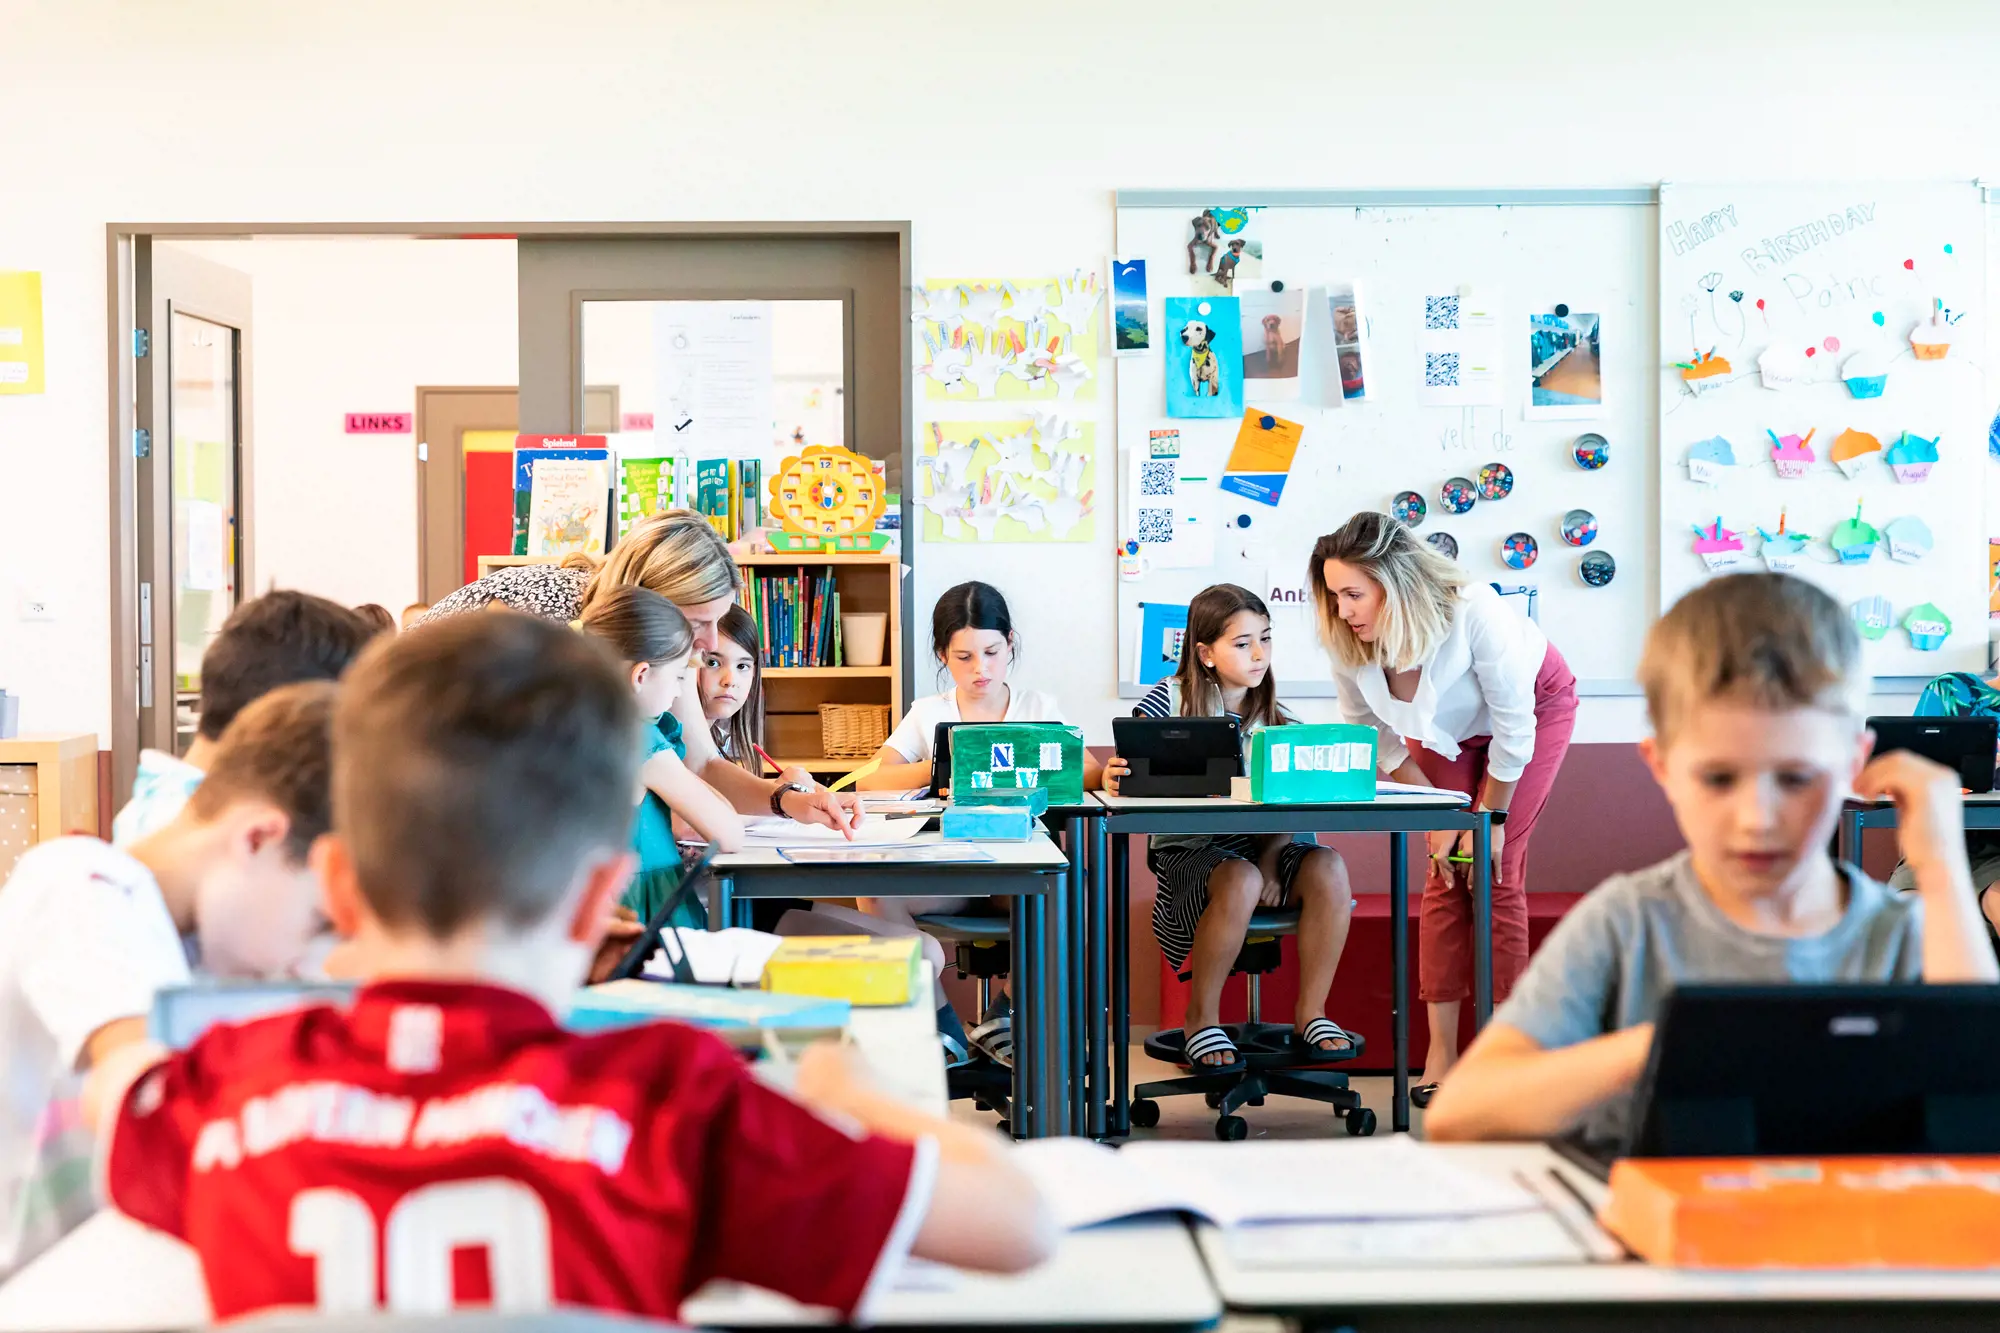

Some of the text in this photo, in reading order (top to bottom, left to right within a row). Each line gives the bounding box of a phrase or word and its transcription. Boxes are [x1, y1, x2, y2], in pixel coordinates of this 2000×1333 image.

[1666, 204, 1738, 256] HAPPY
[352, 416, 404, 429] LINKS
[542, 438, 577, 448] Spielend
[819, 460, 832, 469] 12
[1901, 468, 1929, 483] August
[785, 493, 794, 501] 9
[861, 492, 869, 501] 3
[824, 526, 833, 534] 6
[1270, 587, 1308, 602] Ant
